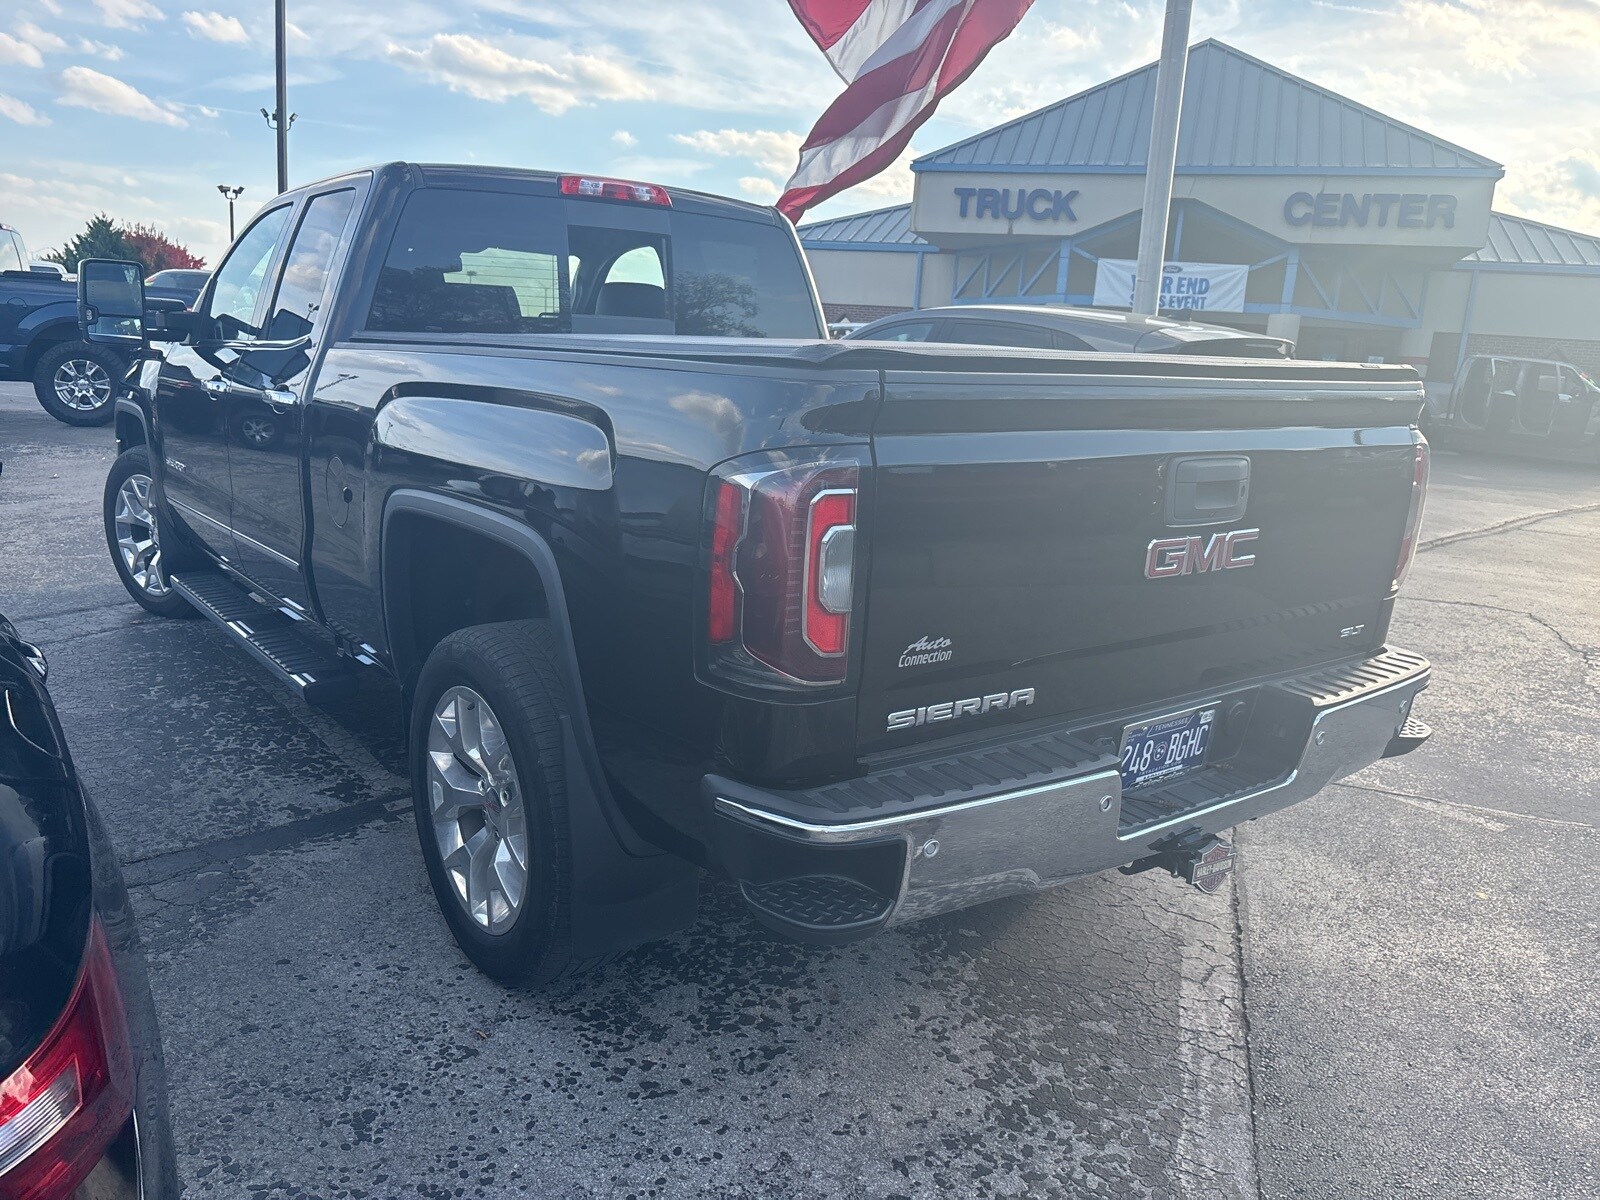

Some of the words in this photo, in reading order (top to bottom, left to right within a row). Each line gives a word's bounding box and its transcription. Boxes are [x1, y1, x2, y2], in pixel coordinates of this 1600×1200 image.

[954, 187, 1080, 221] TRUCK
[1283, 191, 1458, 228] CENTER
[1176, 277, 1210, 295] END
[1168, 296, 1207, 309] EVENT
[1144, 528, 1260, 579] GMC
[1340, 624, 1365, 638] SLT
[903, 635, 953, 654] Auto
[898, 650, 953, 668] Connection
[886, 687, 1035, 732] SIERRA
[1154, 716, 1190, 731] TENNESSEE
[1121, 740, 1154, 776] 248
[1164, 724, 1209, 765] BGHC
